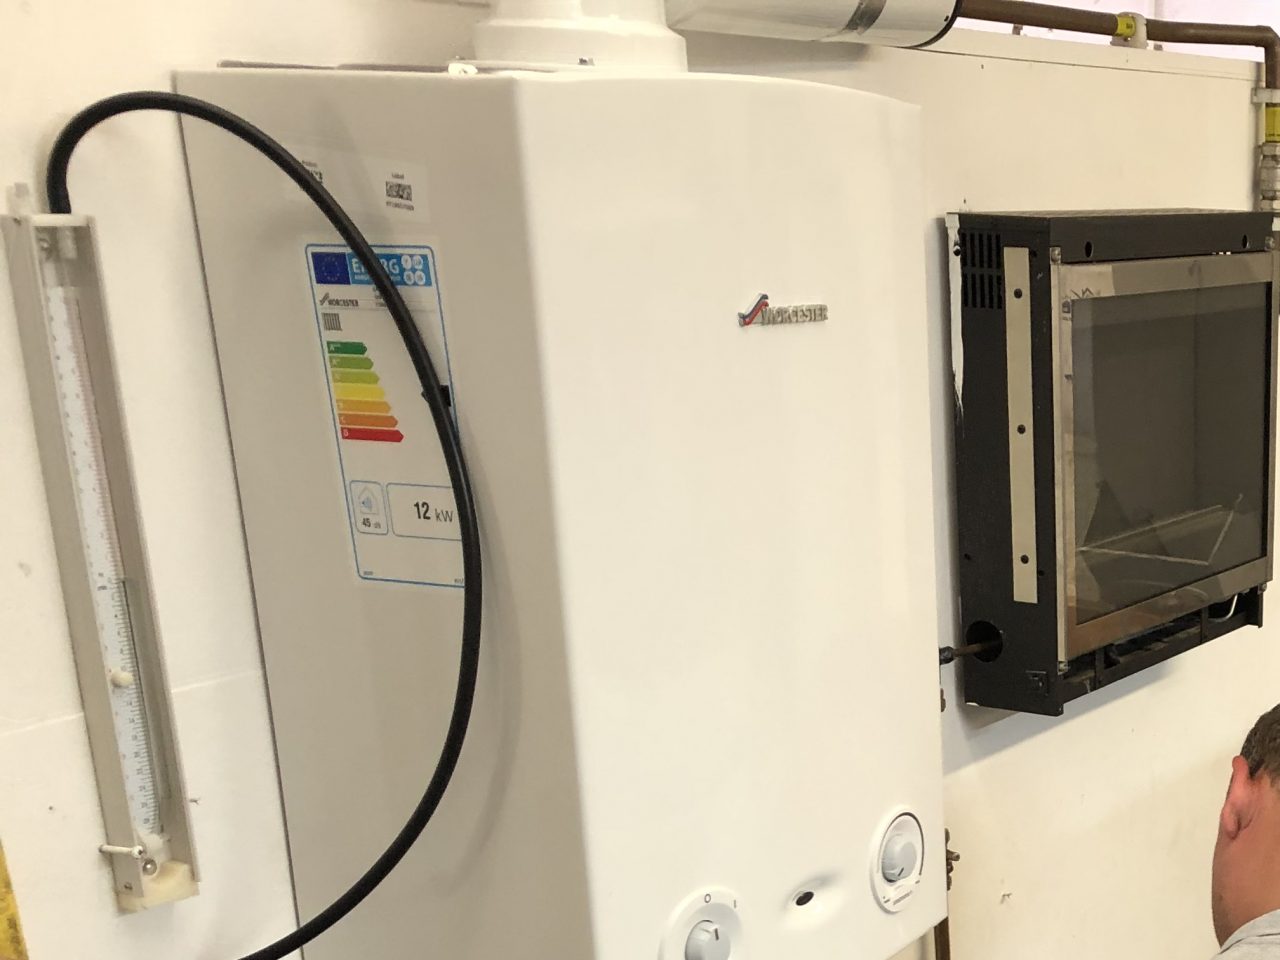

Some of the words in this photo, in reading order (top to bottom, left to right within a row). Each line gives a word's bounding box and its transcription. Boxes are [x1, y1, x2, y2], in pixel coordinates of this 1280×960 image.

[413, 501, 431, 520] 12
[434, 508, 454, 523] kW
[362, 517, 371, 528] 45
